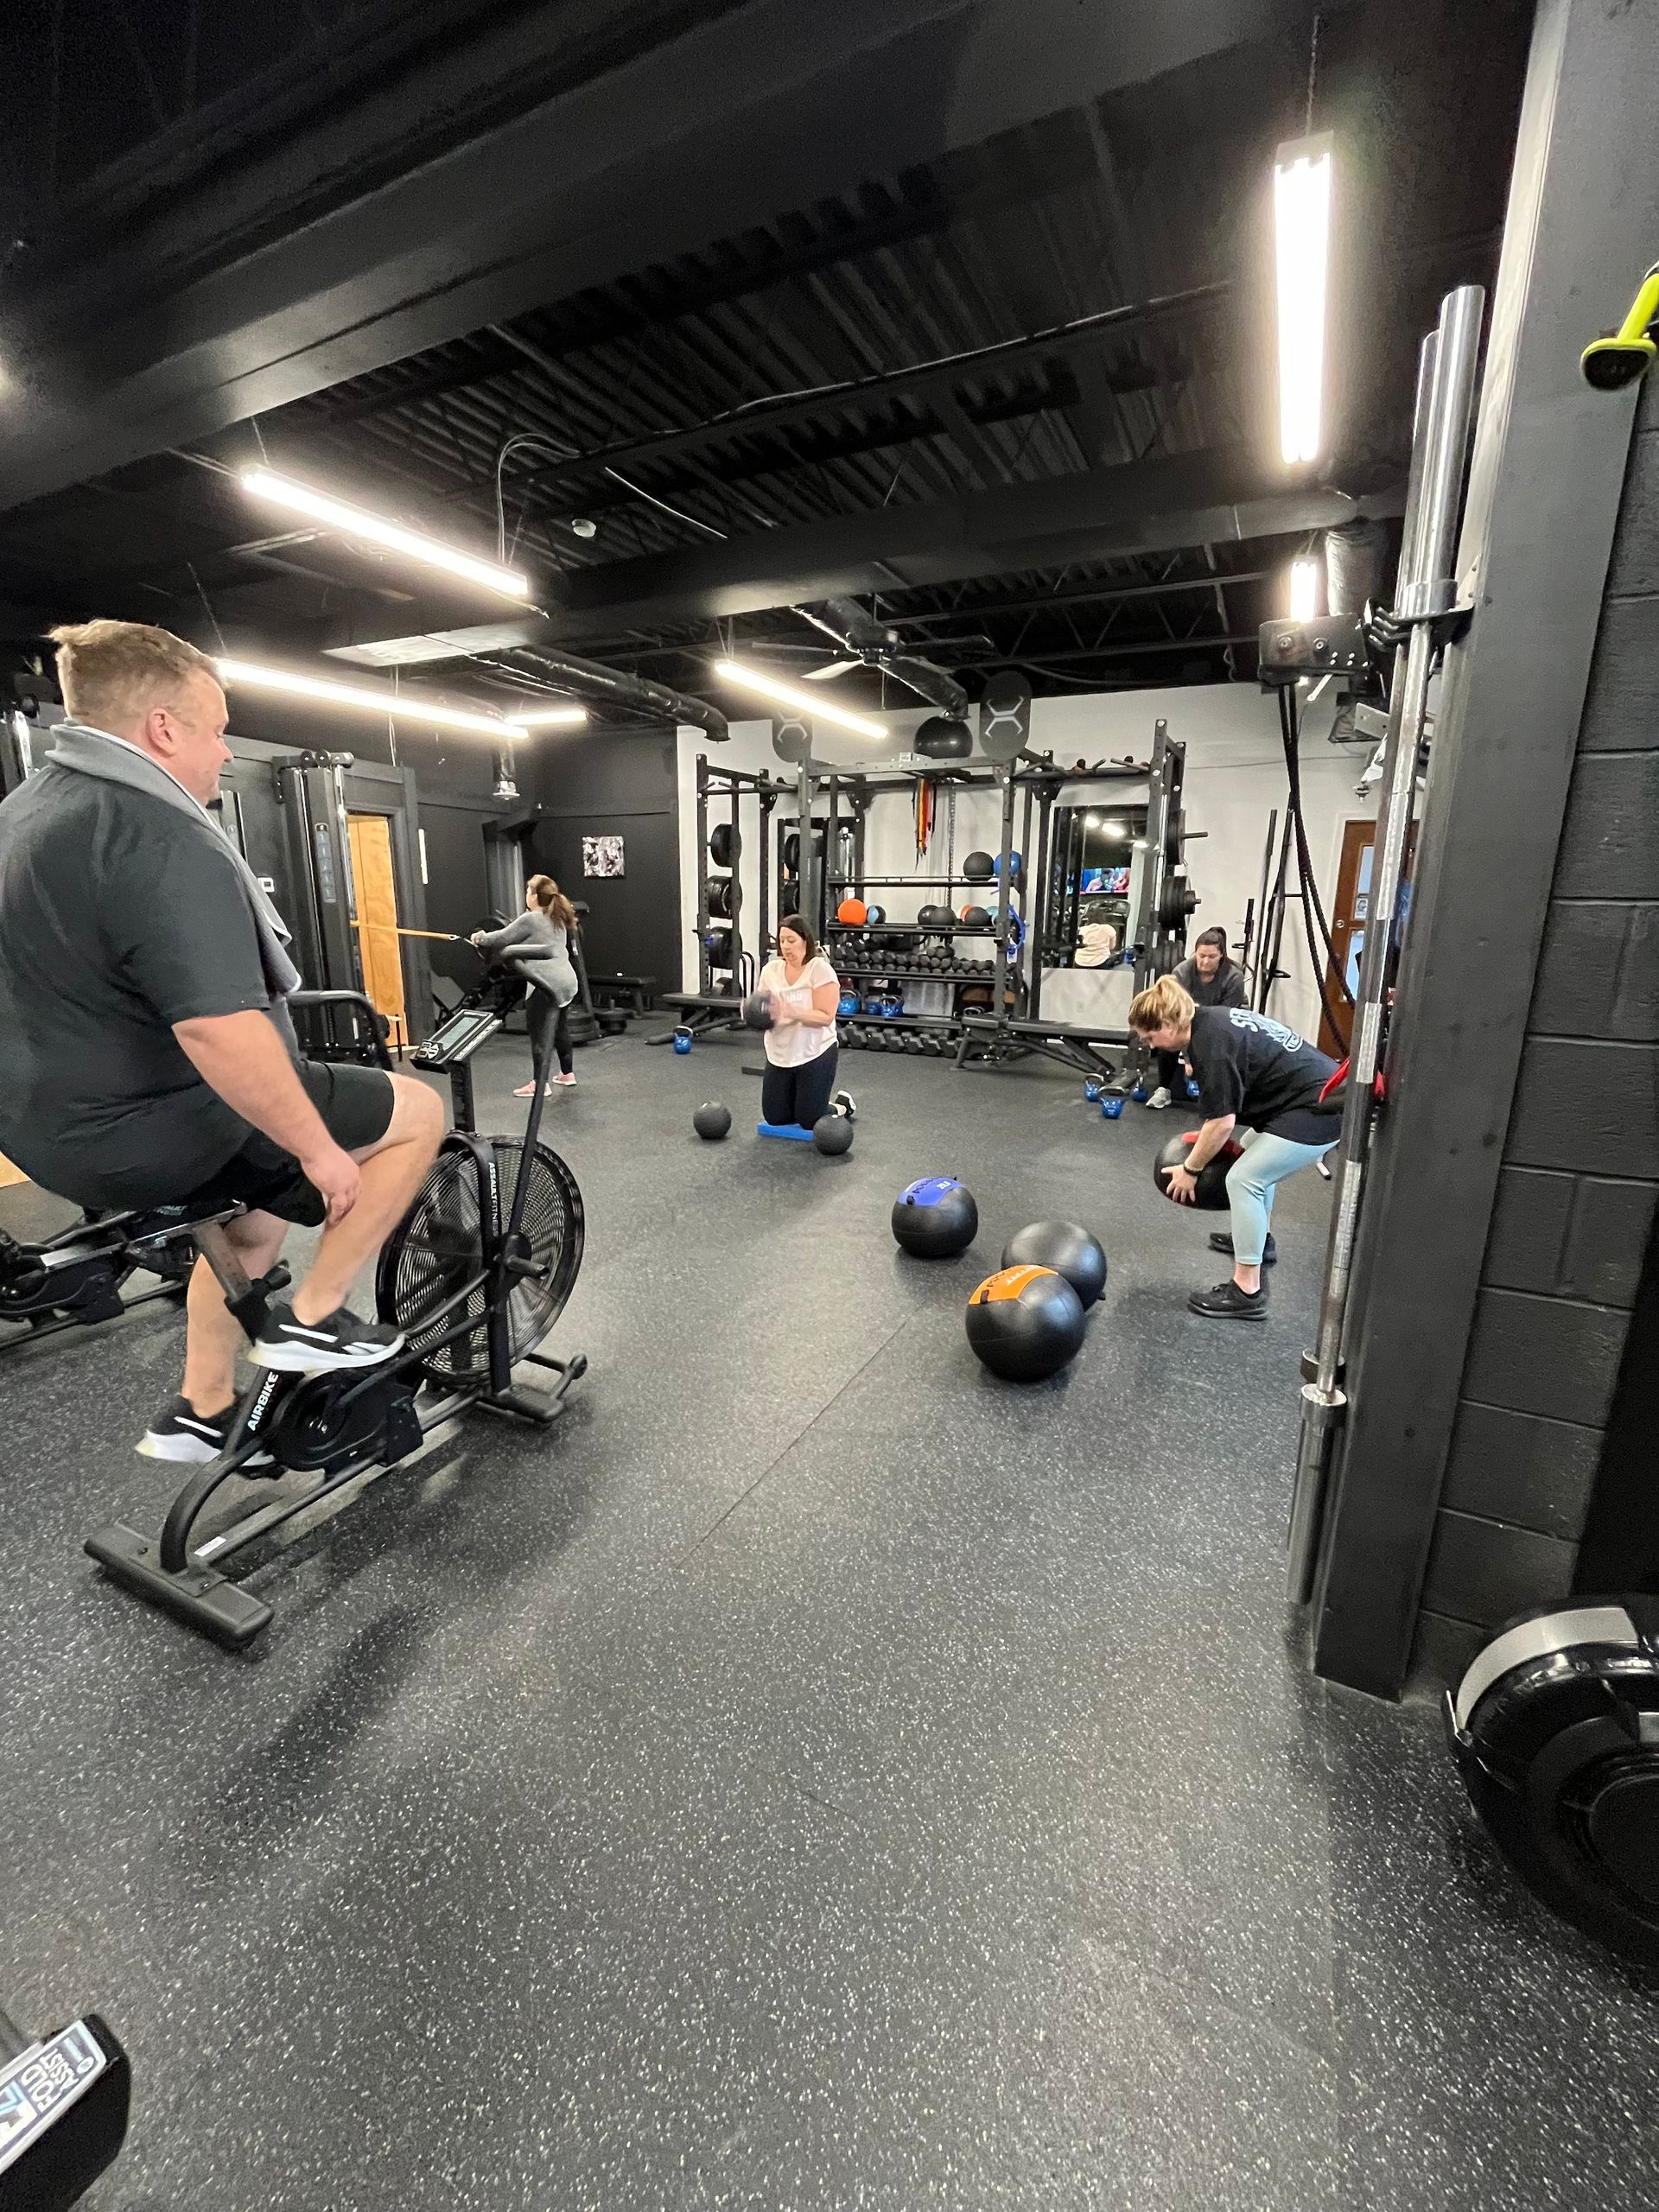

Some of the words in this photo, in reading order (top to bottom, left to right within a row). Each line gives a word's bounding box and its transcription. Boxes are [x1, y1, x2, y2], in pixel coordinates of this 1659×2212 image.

[247, 1371, 279, 1432] AIRBIKE
[20, 2063, 63, 2113] FOLD
[38, 2047, 79, 2092] ASSIST
